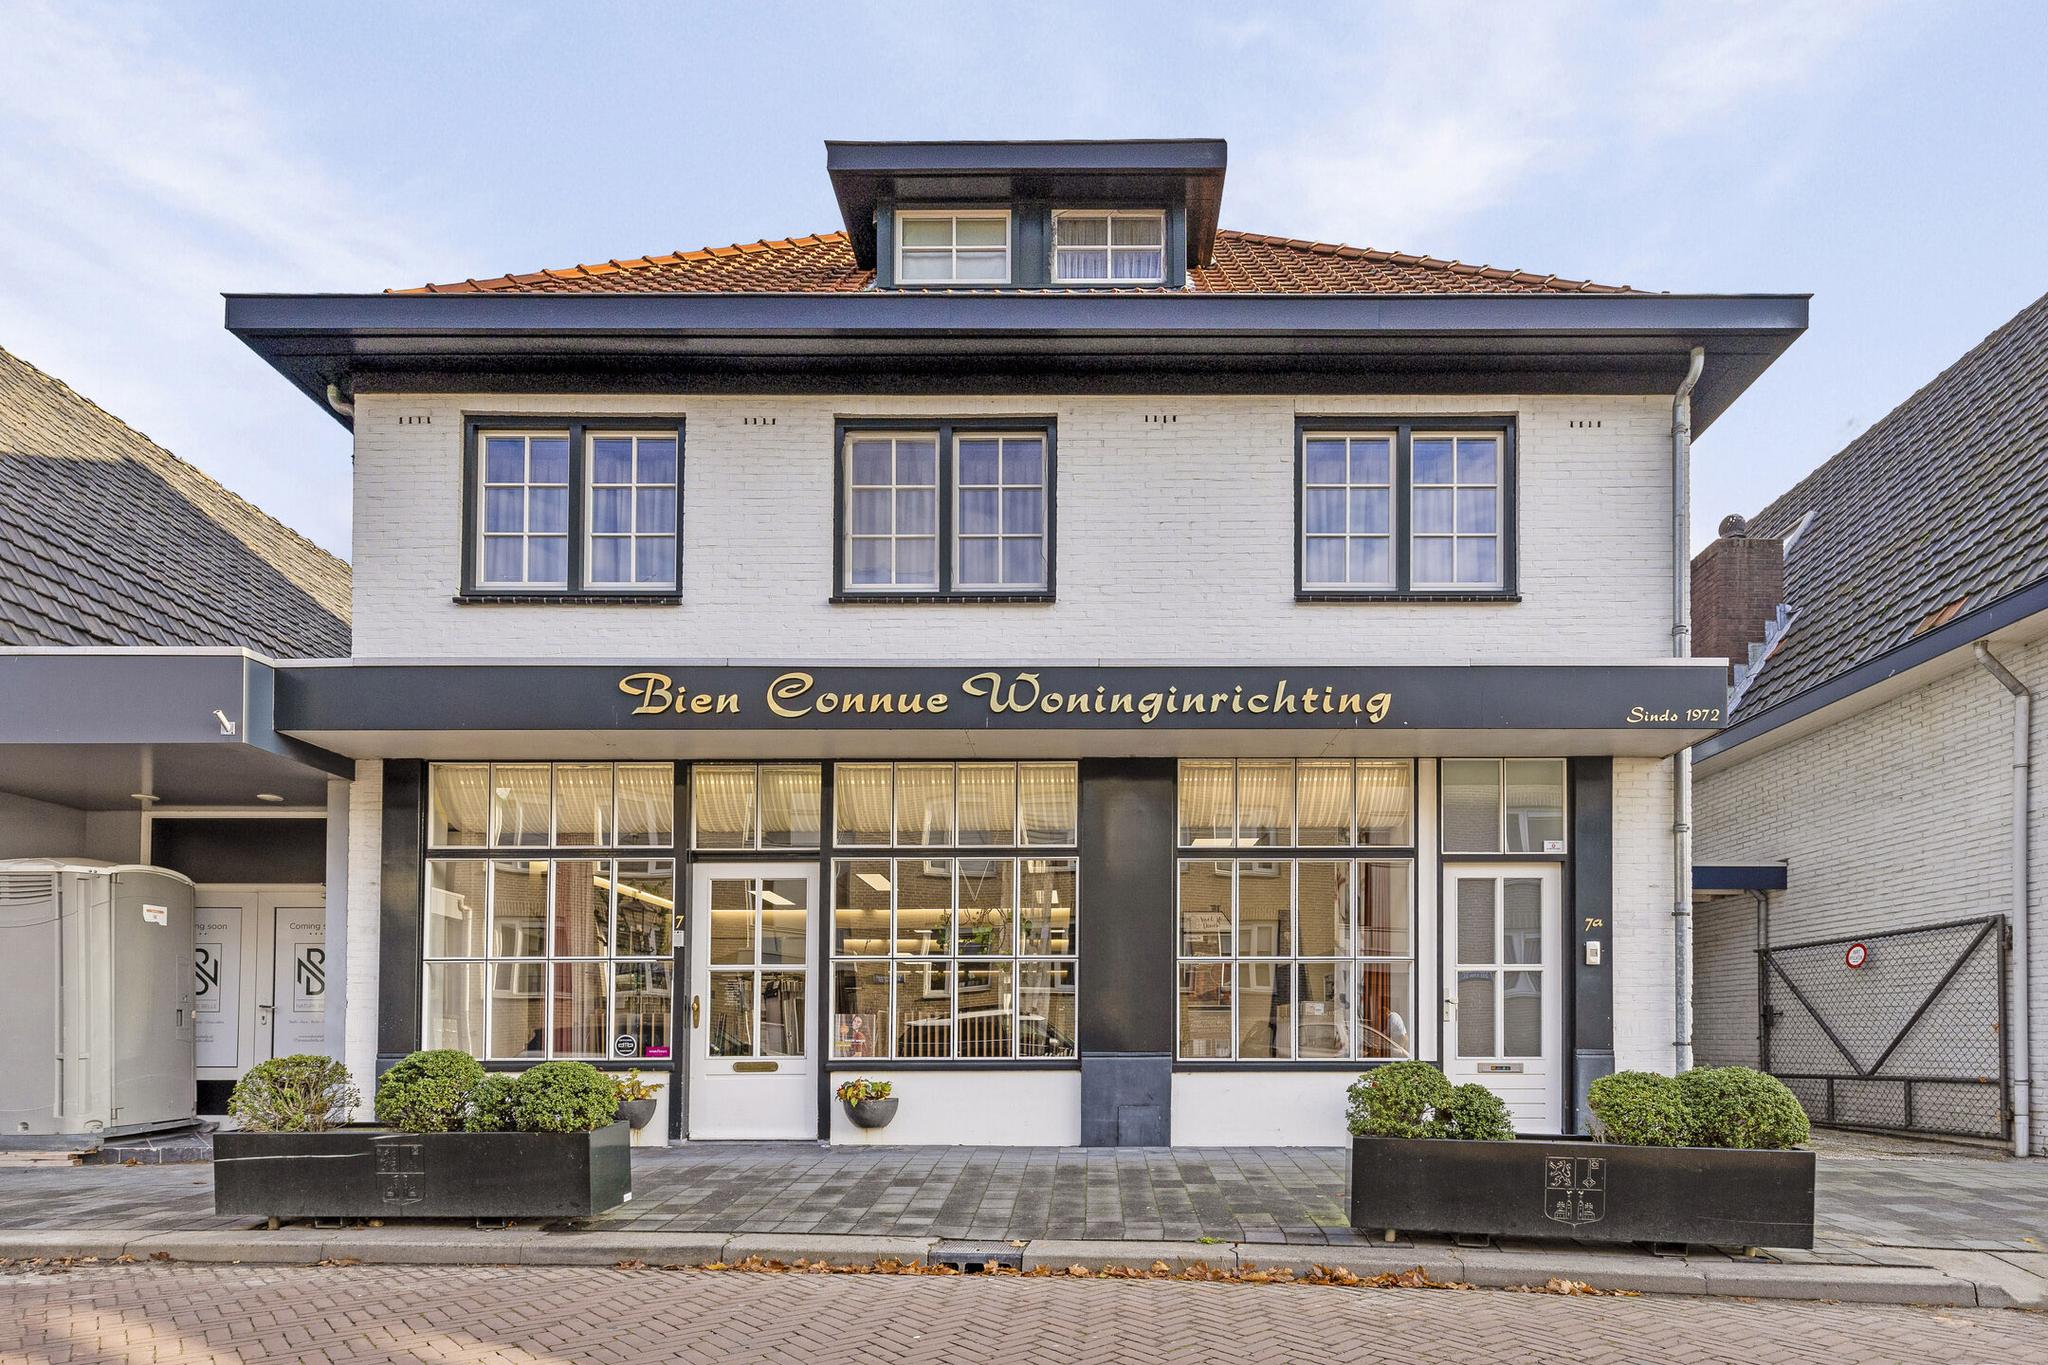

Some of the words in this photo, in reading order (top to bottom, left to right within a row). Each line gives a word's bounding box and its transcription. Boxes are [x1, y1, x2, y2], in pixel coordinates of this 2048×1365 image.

[618, 672, 741, 715] Bien
[766, 672, 949, 718] Connue
[962, 671, 1392, 724] Woninginrichting
[1626, 706, 1678, 723] Sinds
[1685, 709, 1720, 722] 1972
[207, 922, 228, 931] soon
[289, 922, 321, 931] Coming
[675, 915, 685, 929] 7
[1584, 918, 1604, 932] 7a
